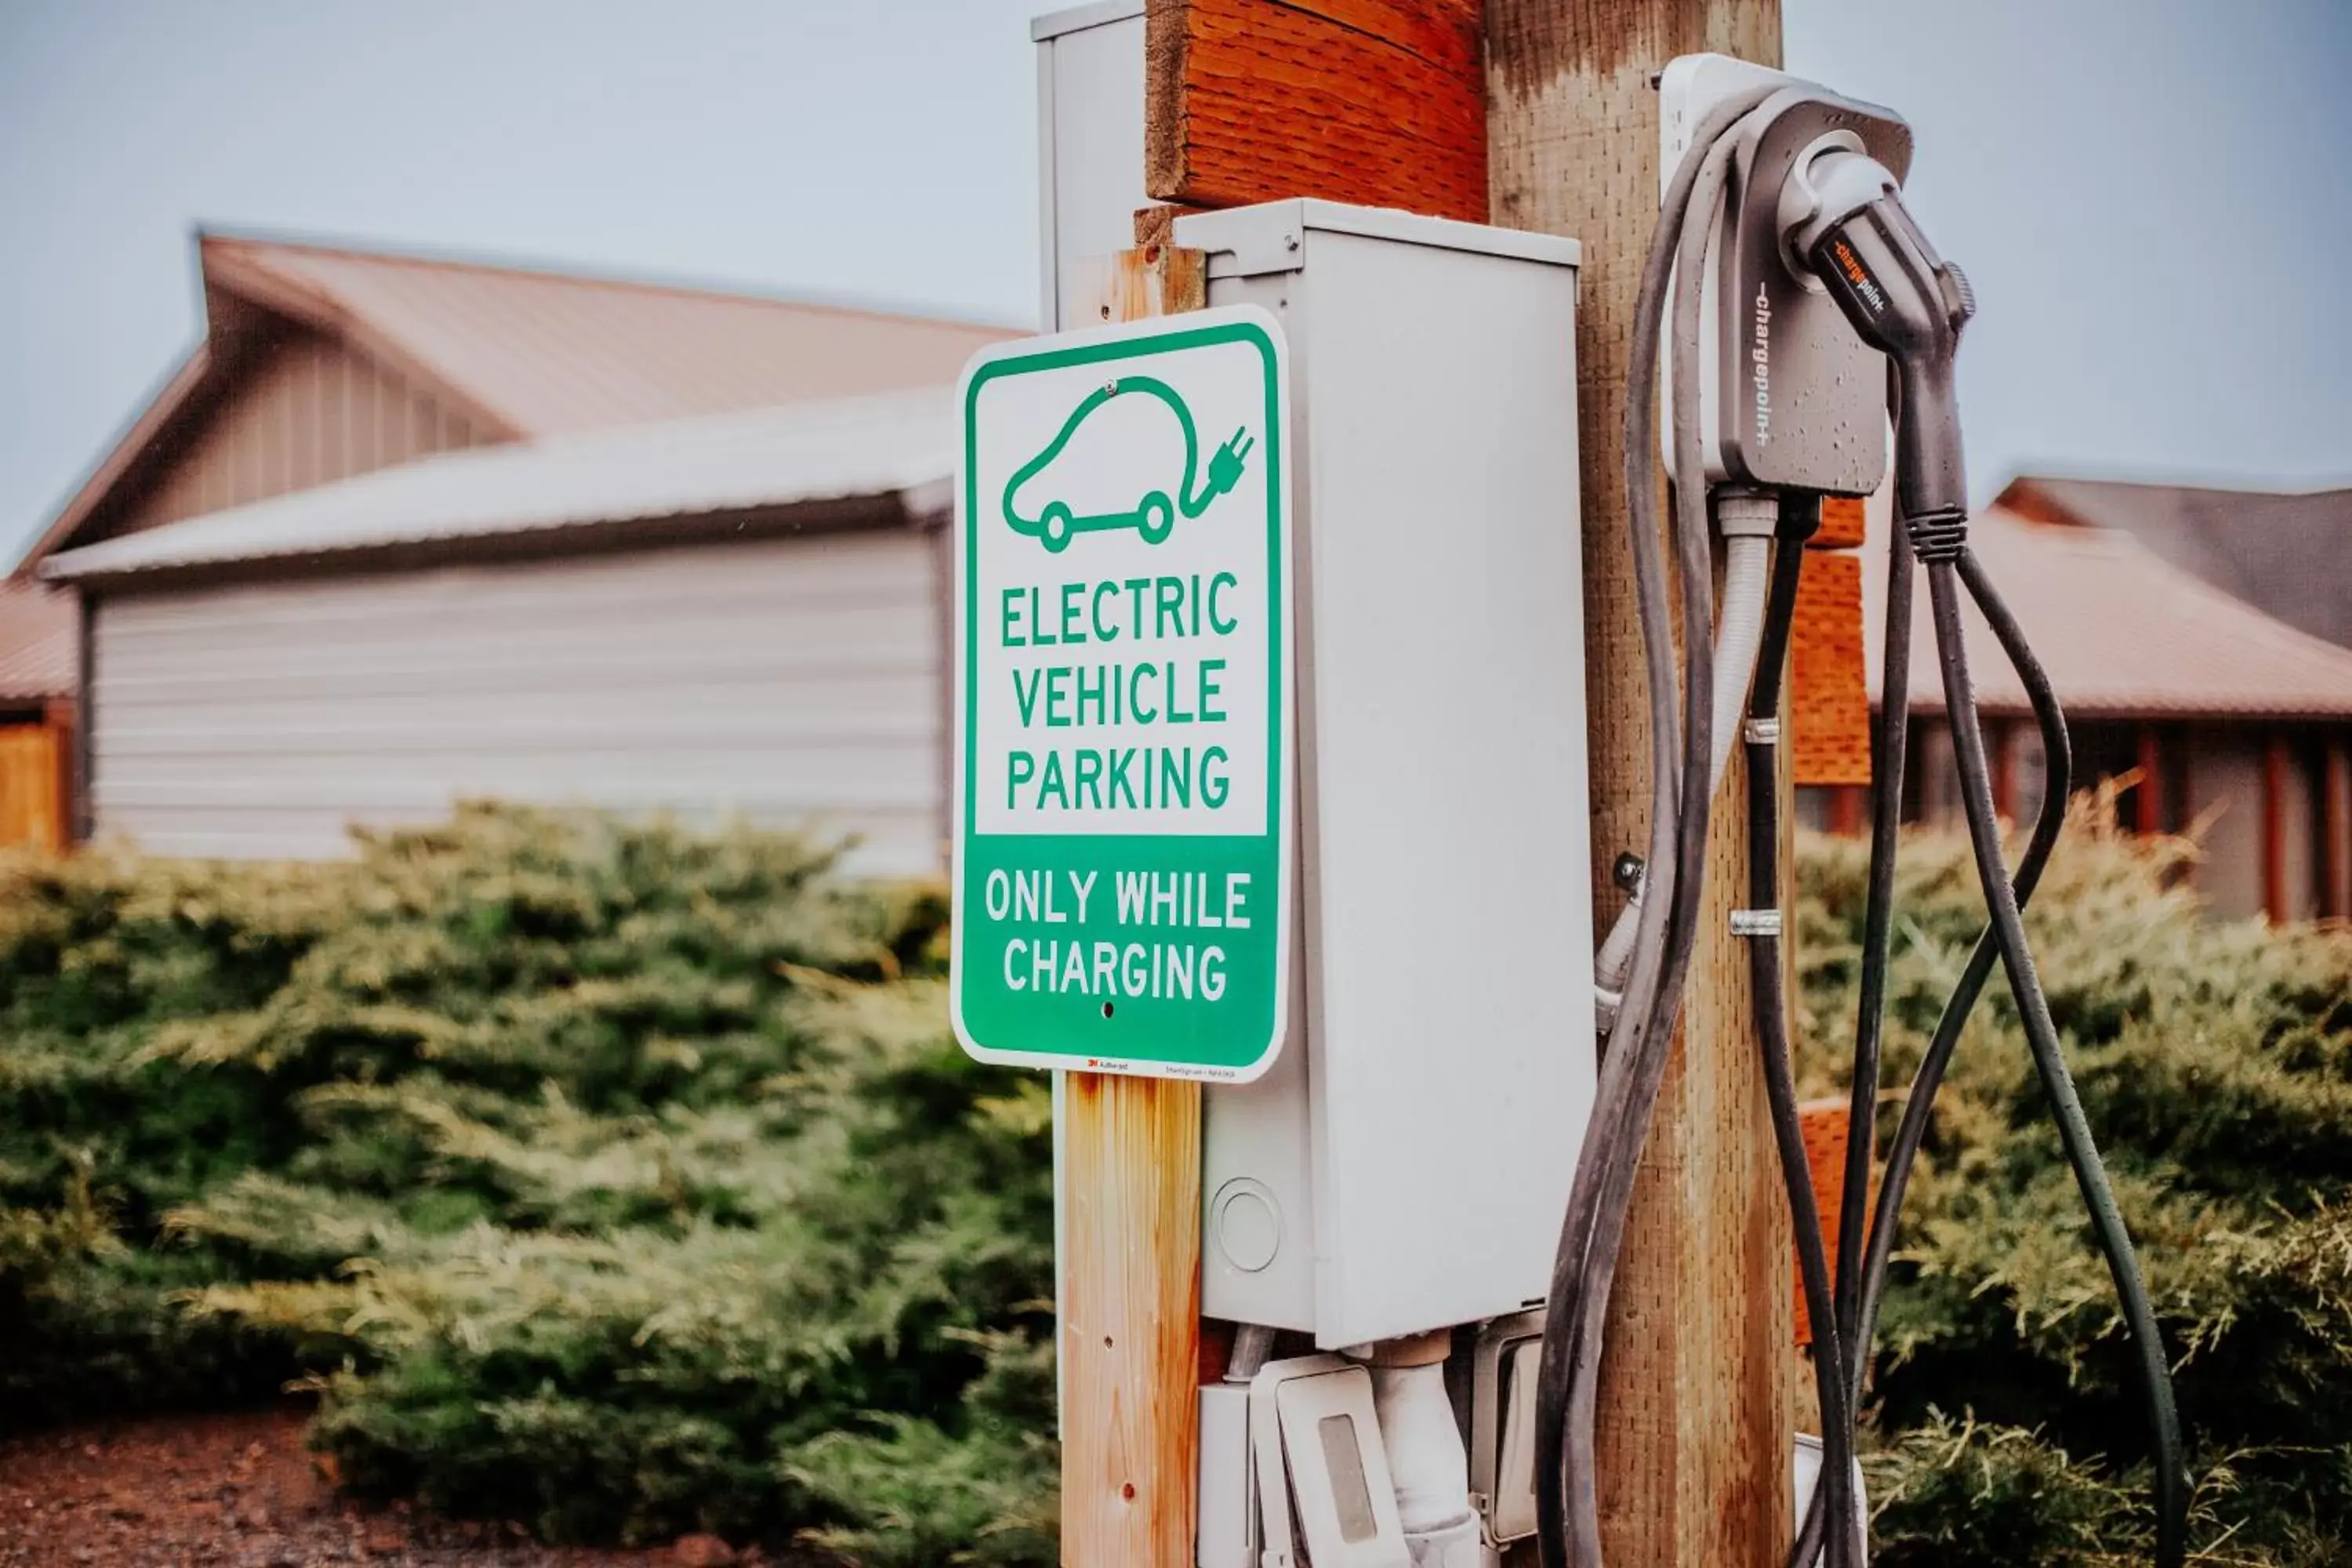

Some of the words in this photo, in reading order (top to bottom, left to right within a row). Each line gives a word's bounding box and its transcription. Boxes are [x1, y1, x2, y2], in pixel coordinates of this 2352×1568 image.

[1002, 572, 1238, 647] ELECTRIC
[1012, 659, 1227, 728] VEHICLE
[1007, 746, 1229, 810] PARKING
[985, 868, 1098, 924] ONLY
[1116, 871, 1252, 929] WHILE
[1003, 938, 1228, 1002] CHARGING
